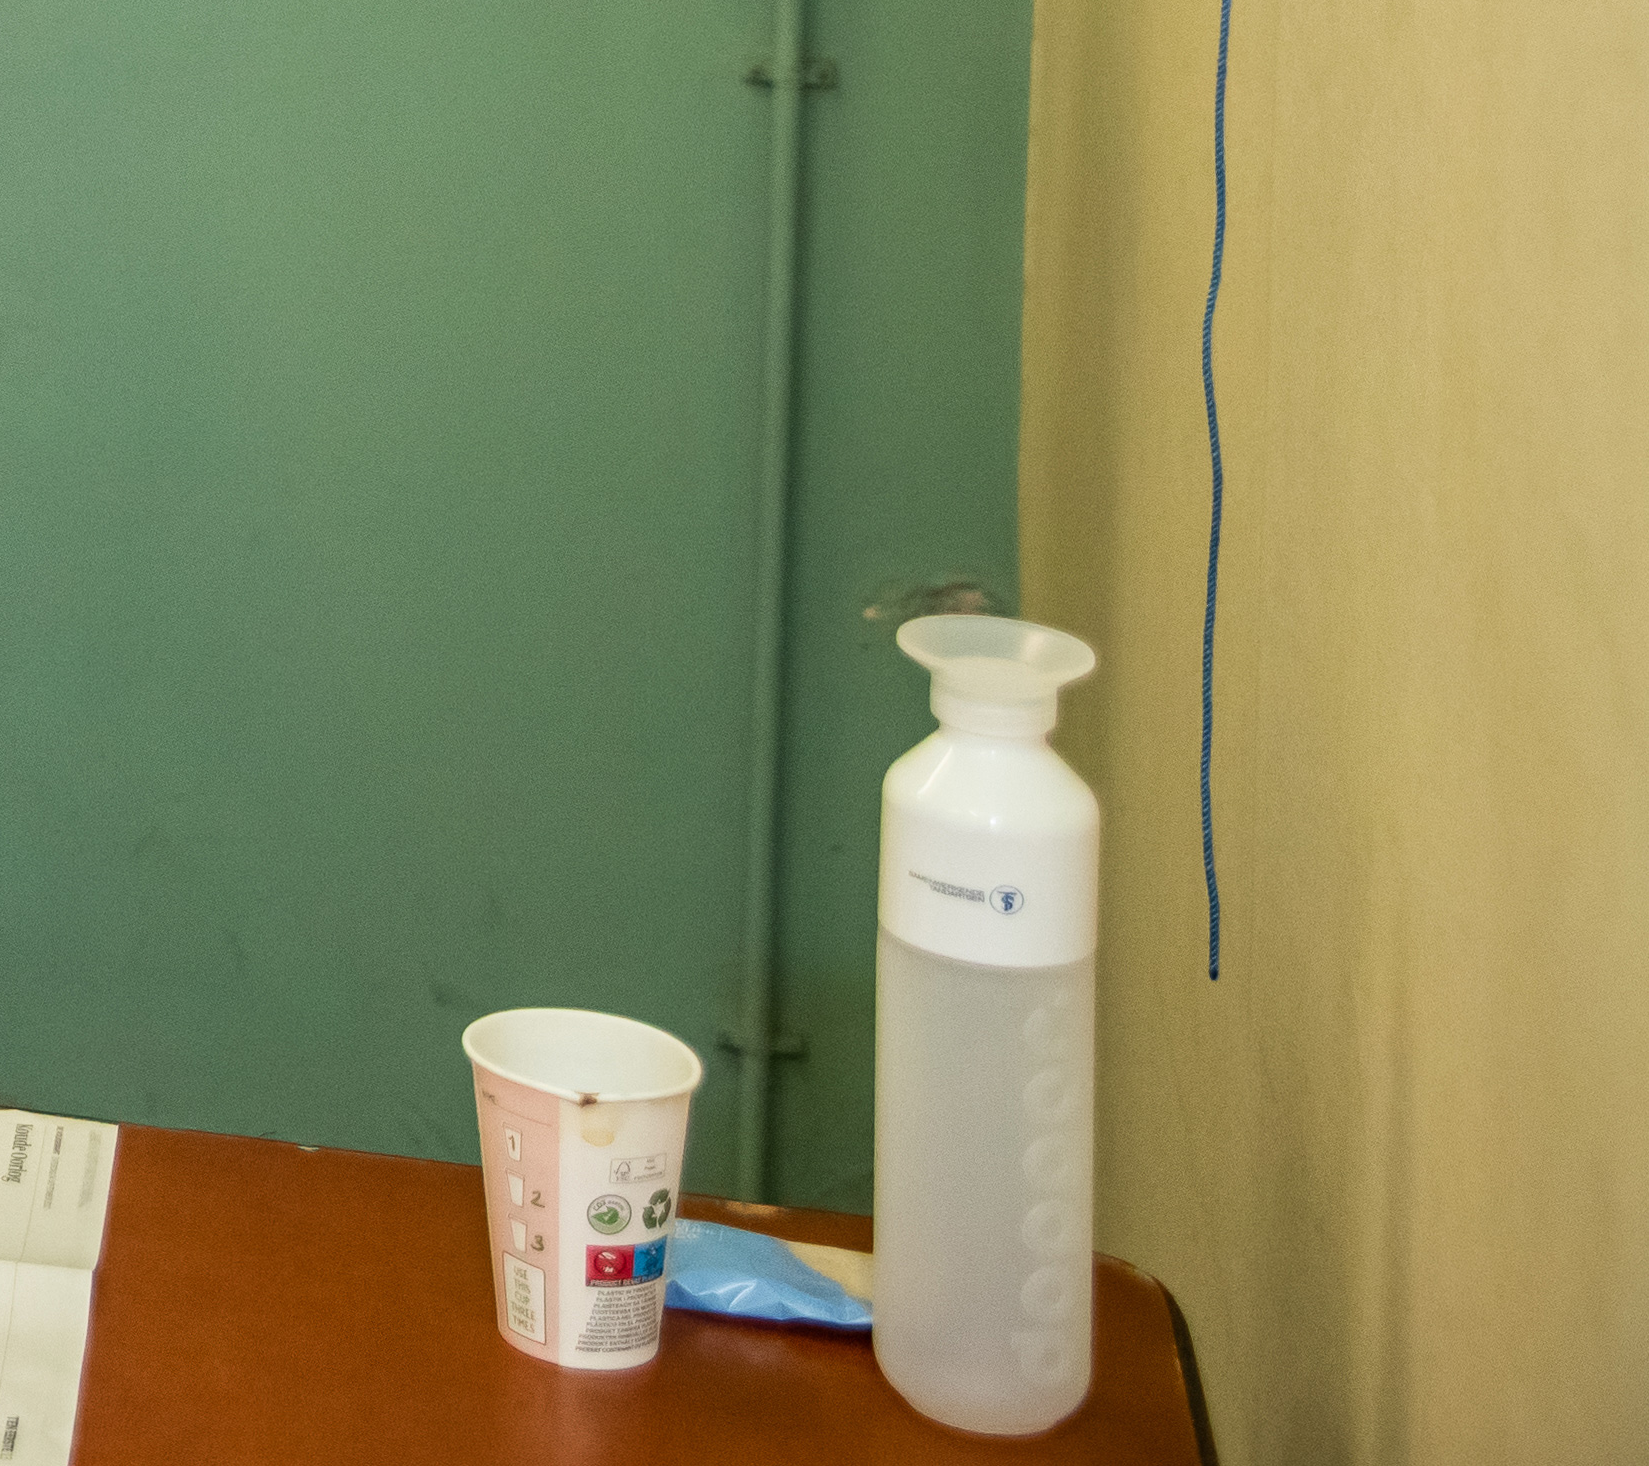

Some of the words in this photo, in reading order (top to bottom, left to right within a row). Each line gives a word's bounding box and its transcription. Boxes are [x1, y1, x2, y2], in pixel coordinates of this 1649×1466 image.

[12, 1123, 34, 1151] Koude
[1, 1152, 28, 1184] Oorlog
[530, 1190, 546, 1209] 2
[530, 1234, 545, 1252] 3
